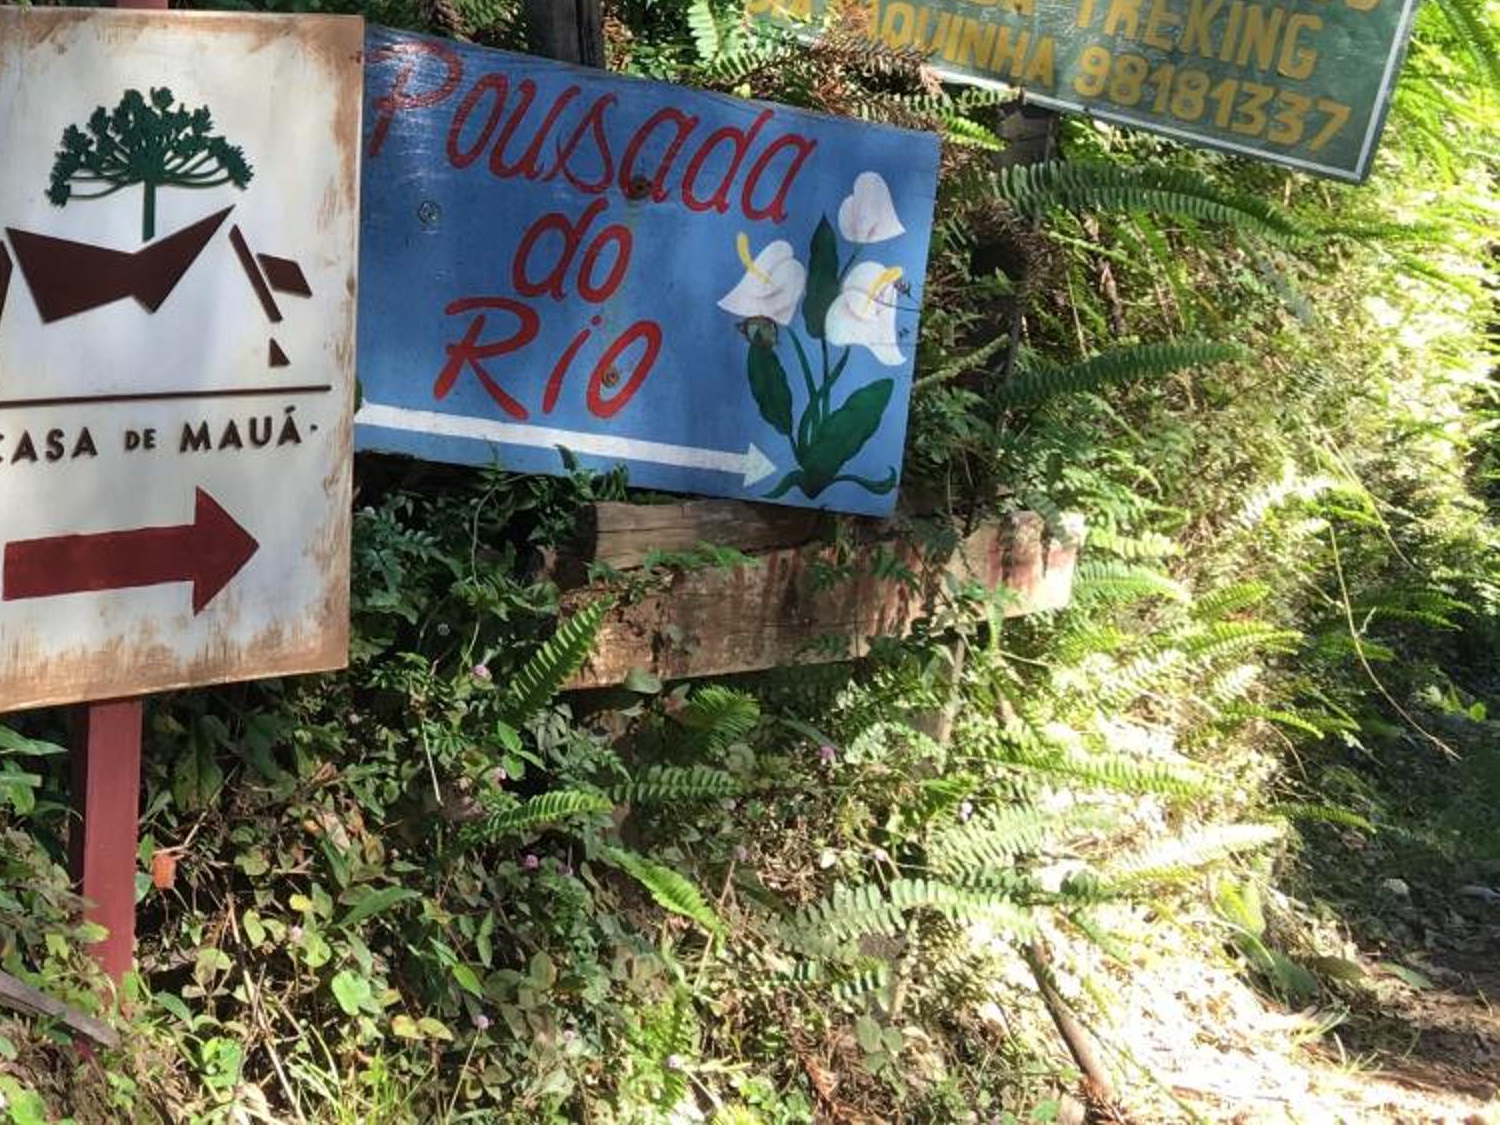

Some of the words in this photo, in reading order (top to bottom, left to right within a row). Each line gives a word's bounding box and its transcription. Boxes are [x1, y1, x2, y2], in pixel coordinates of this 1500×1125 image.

[364, 39, 818, 224] Pousada
[1073, 45, 1352, 154] 98181337
[511, 191, 632, 304] do
[124, 428, 157, 452] DE
[179, 405, 304, 454] MAUÁ
